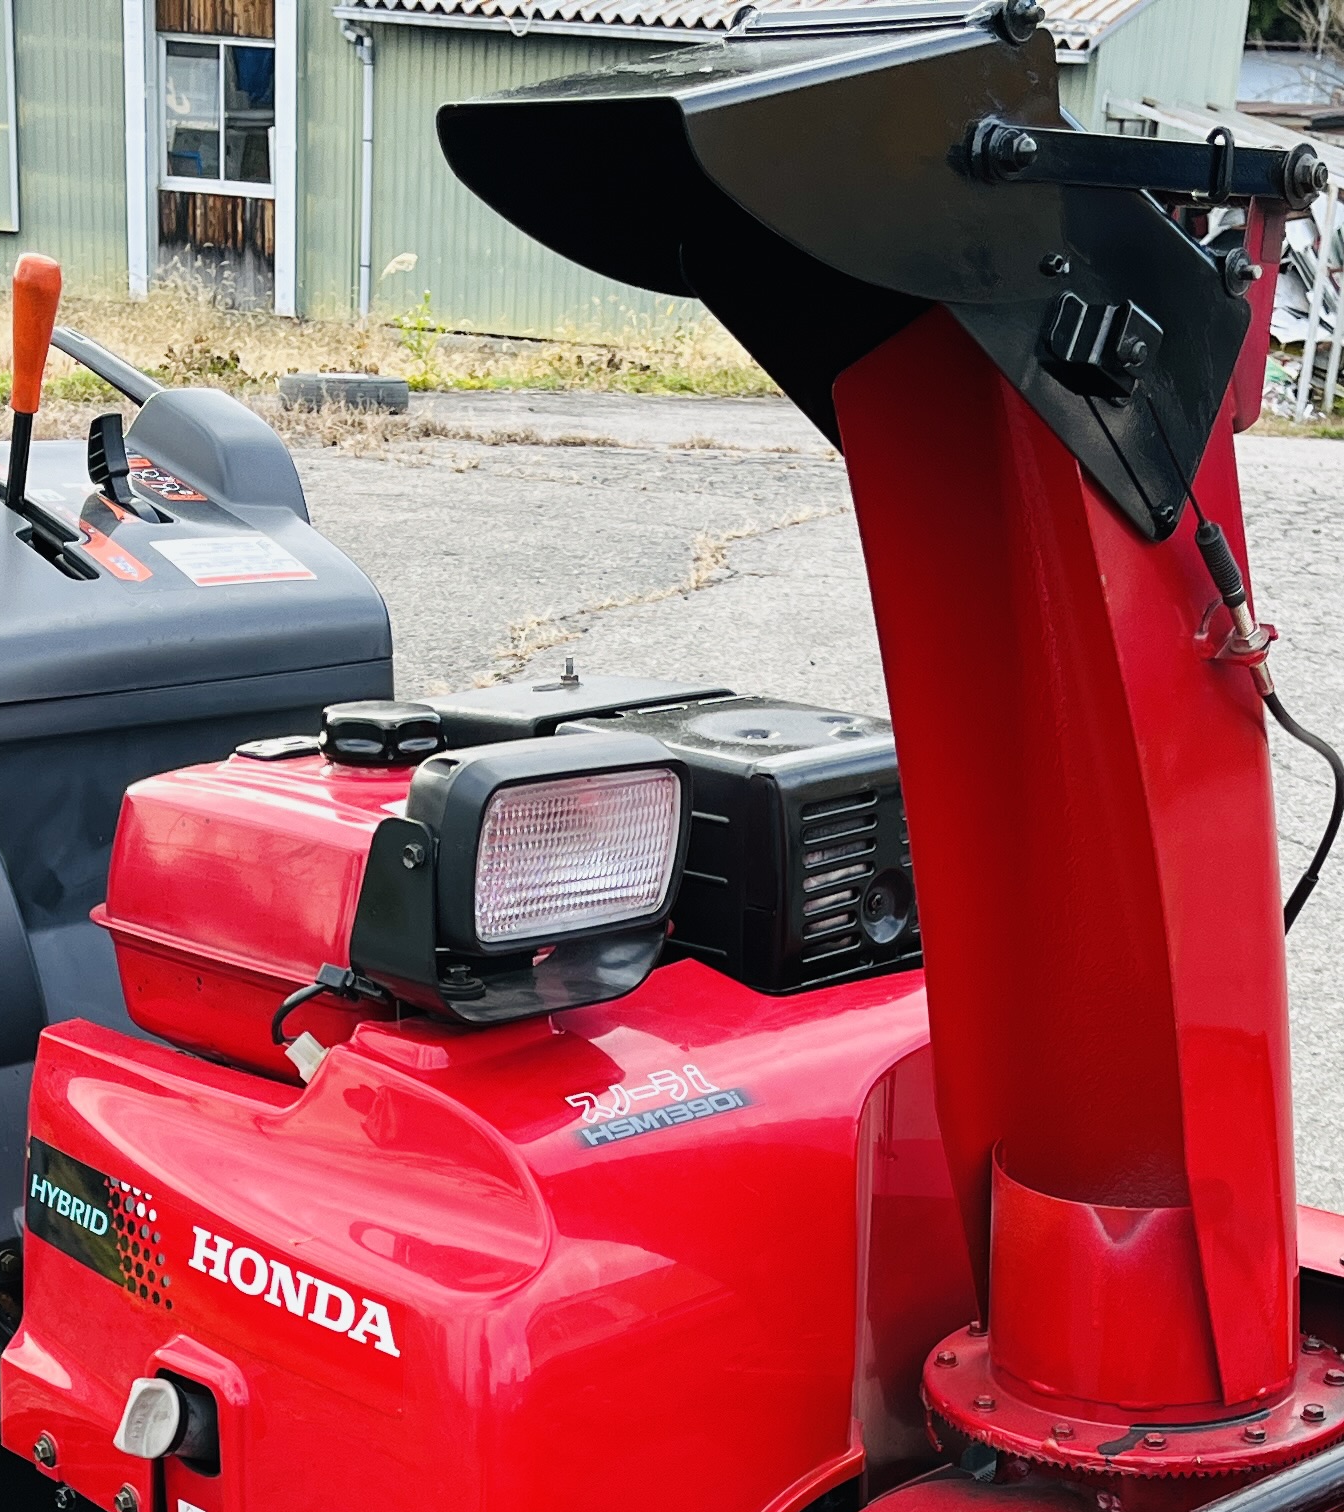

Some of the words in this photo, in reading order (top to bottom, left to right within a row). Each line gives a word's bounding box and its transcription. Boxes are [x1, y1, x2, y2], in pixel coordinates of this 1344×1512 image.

[581, 1090, 745, 1147] HSM1390i
[30, 1173, 110, 1237] HYBRID
[187, 1224, 402, 1358] HONDA
